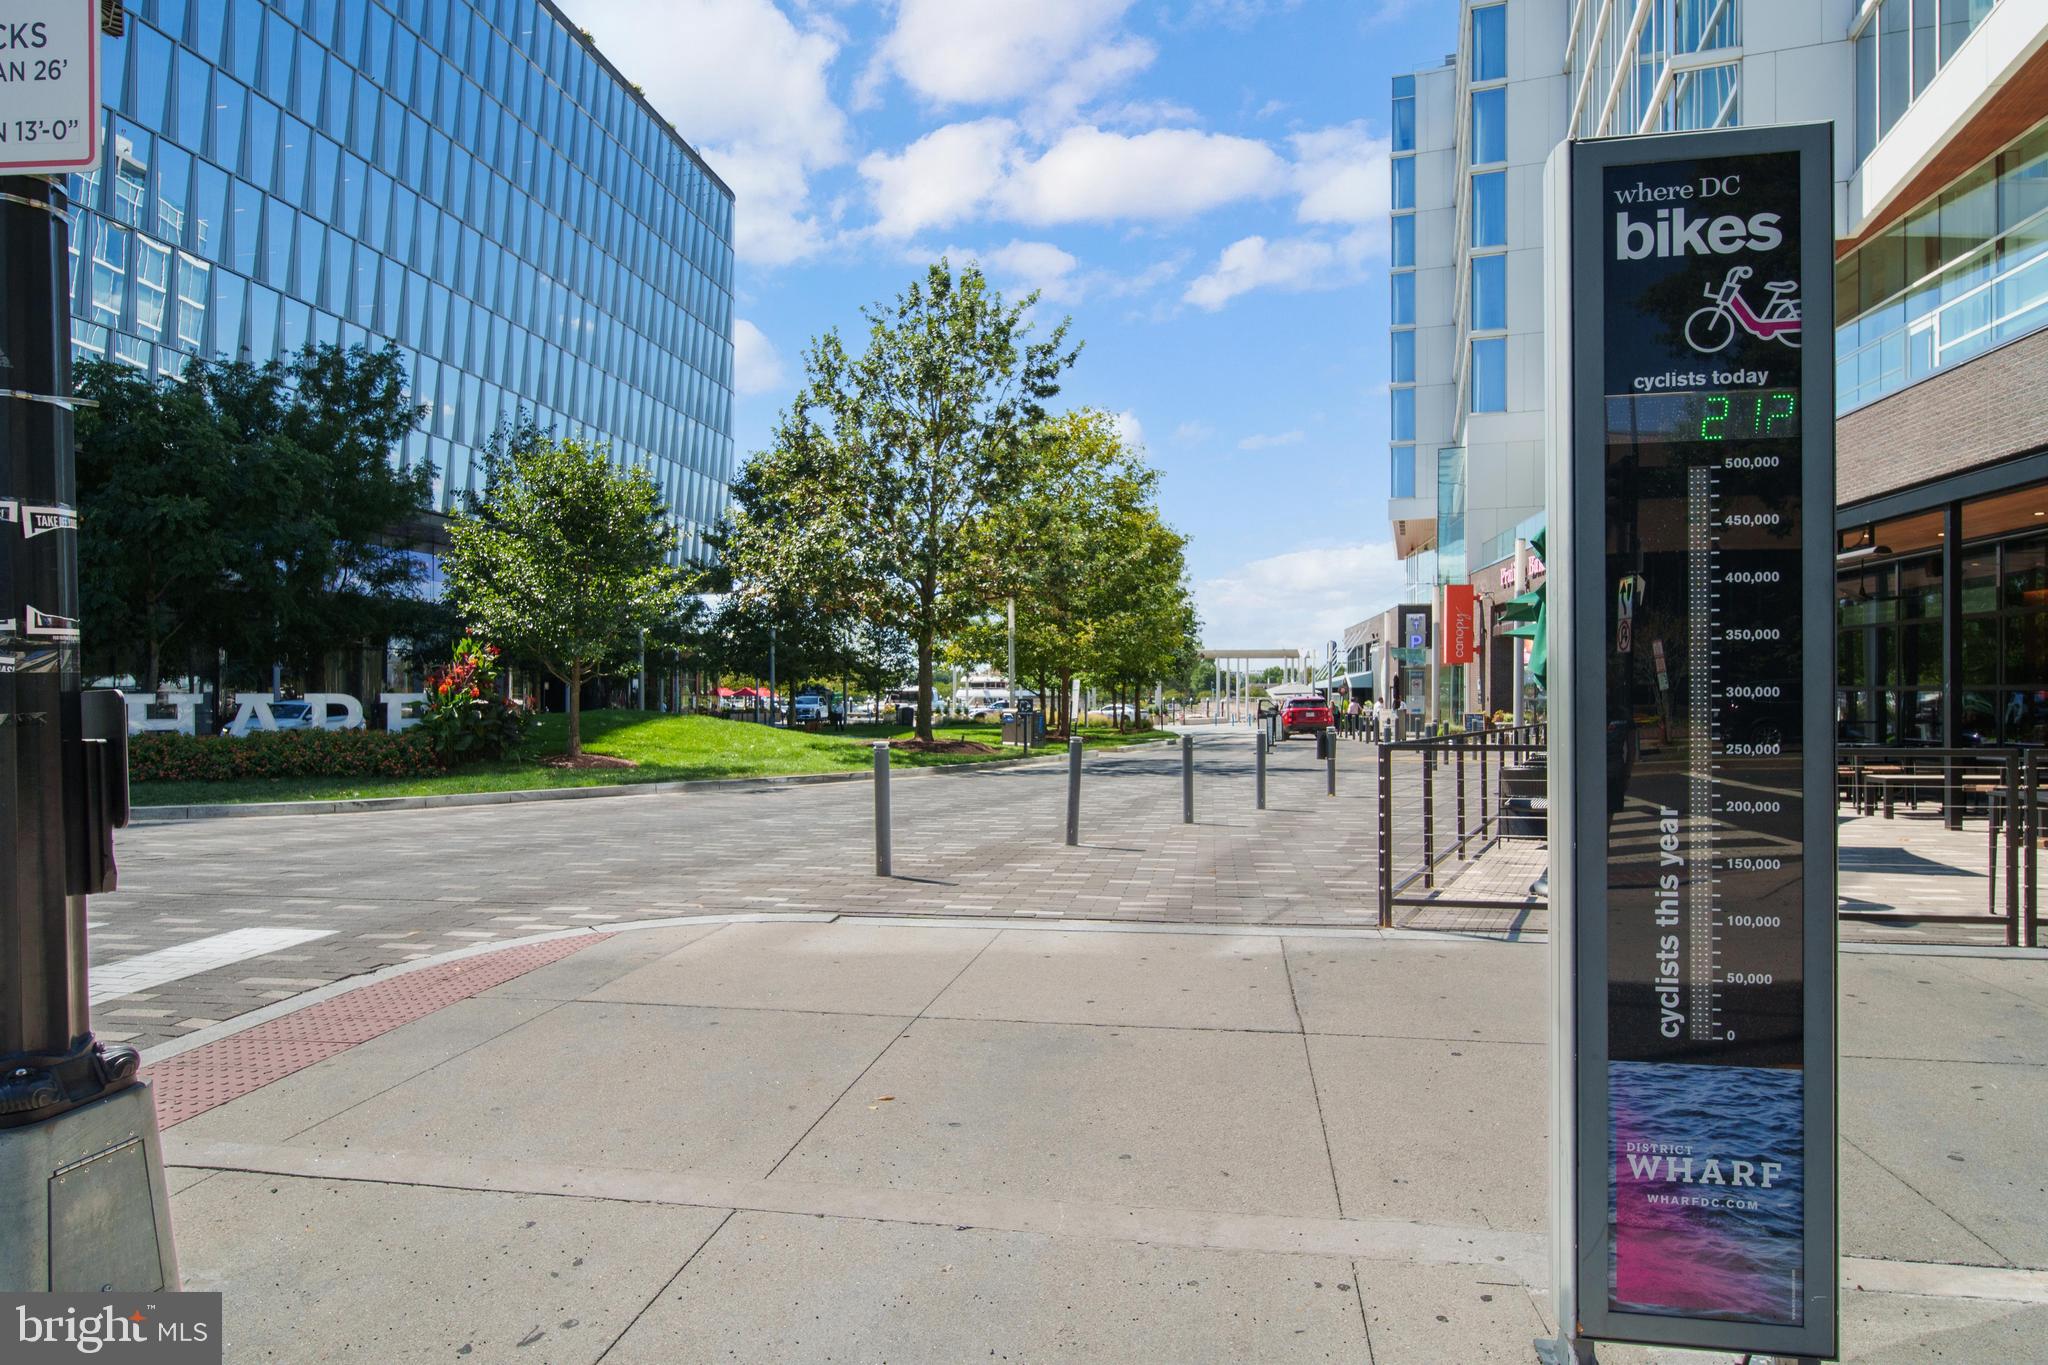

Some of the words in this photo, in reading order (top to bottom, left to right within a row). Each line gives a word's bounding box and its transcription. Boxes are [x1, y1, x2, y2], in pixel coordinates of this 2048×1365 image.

[1614, 182, 1694, 204] where
[1700, 175, 1741, 198] DC
[1616, 207, 1783, 260] bikes
[1634, 369, 1707, 391] cyclists
[1712, 369, 1769, 386] today
[1724, 456, 1780, 470] 500,000
[35, 514, 58, 528] TAKE
[1724, 514, 1780, 527] 450,000
[1724, 571, 1780, 585] 400,000
[1725, 629, 1780, 642] 350,000
[1725, 686, 1780, 700] 300,000
[1725, 744, 1780, 757] 250,000
[1725, 801, 1780, 814] 200,000
[1660, 805, 1684, 866] year
[1726, 859, 1781, 872] 150,000
[1654, 874, 1680, 927] this
[1726, 916, 1781, 928] 100,000
[1726, 973, 1773, 985] 50,000
[1655, 935, 1685, 1038] cyclists
[1726, 1031, 1736, 1041] 0
[1626, 1142, 1693, 1155] DISTRICT
[1626, 1154, 1782, 1188] WHARF
[1647, 1194, 1758, 1210] WHARFDC.COM
